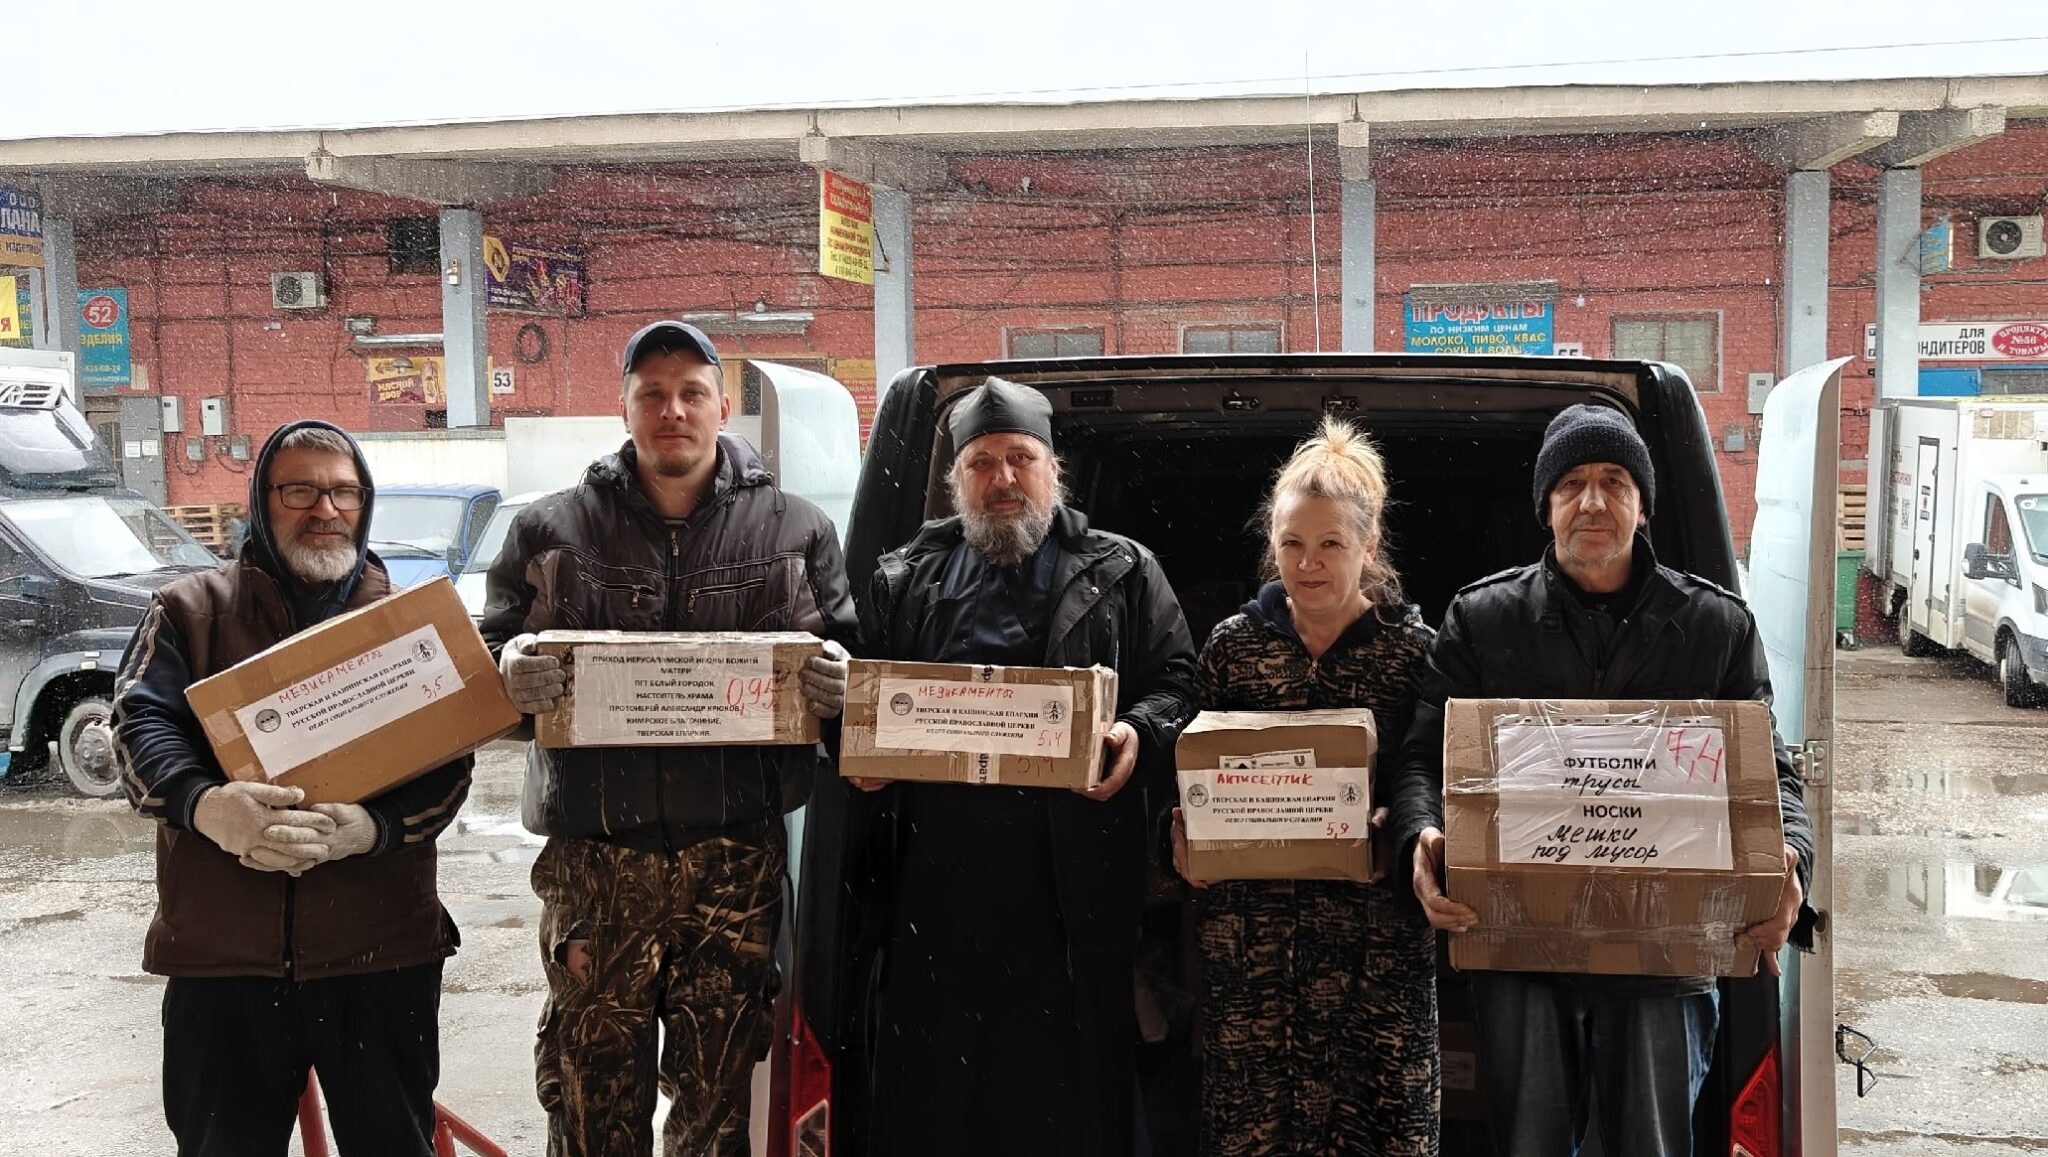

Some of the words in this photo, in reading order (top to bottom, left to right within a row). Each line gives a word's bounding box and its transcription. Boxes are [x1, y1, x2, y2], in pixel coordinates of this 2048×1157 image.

[88, 306, 112, 323] 52
[1430, 326, 1445, 335] ПО
[1448, 325, 1490, 334] НИЗКИМ
[1493, 323, 1528, 332] ЦЕНАМ
[1959, 328, 1985, 339] ДЛЯ
[1514, 332, 1546, 343] КВАС
[1918, 340, 1985, 356] НДИТЕРОВ
[493, 372, 511, 389] 53
[592, 656, 625, 664] ПРИХОД
[421, 675, 443, 699] 3,5
[650, 679, 677, 687] БЕЛЫЙ
[609, 704, 659, 712] ПРОТОИЕРЕЙ
[292, 707, 327, 728] РУССКОЙ
[914, 717, 948, 725] РУССКОЙ
[1563, 756, 1656, 770] ФУТБОЛКИ
[1666, 729, 1722, 784] 7,4
[1562, 774, 1642, 796] трусы
[1212, 806, 1246, 814] РУССКОЙ
[1583, 804, 1642, 818] НОСКИ
[1326, 821, 1350, 839] 5,9
[1531, 845, 1571, 862] под
